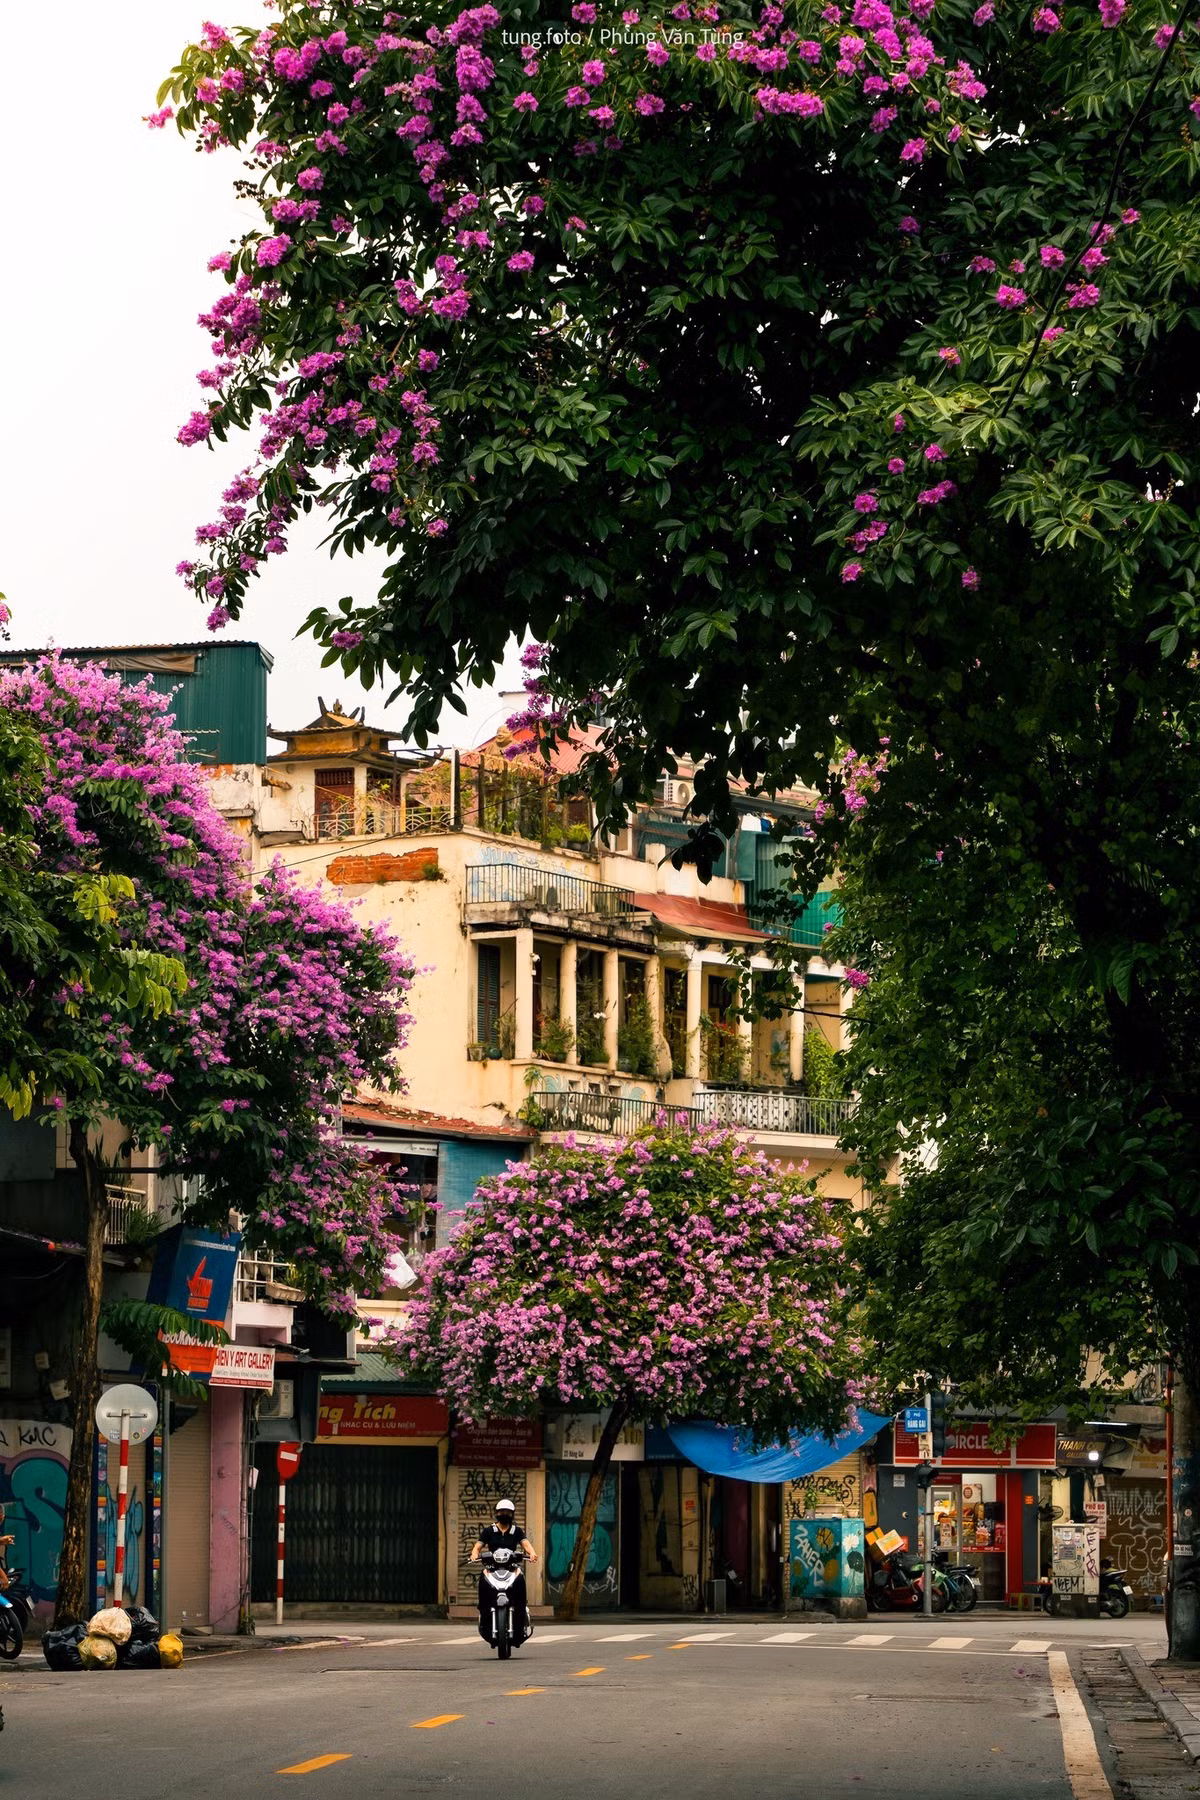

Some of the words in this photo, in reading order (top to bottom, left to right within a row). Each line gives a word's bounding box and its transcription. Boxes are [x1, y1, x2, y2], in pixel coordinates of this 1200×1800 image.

[235, 1351, 248, 1368] ART
[248, 1353, 275, 1370] GALLERY
[353, 1401, 397, 1420] Tích
[1057, 1440, 1085, 1451] THANH
